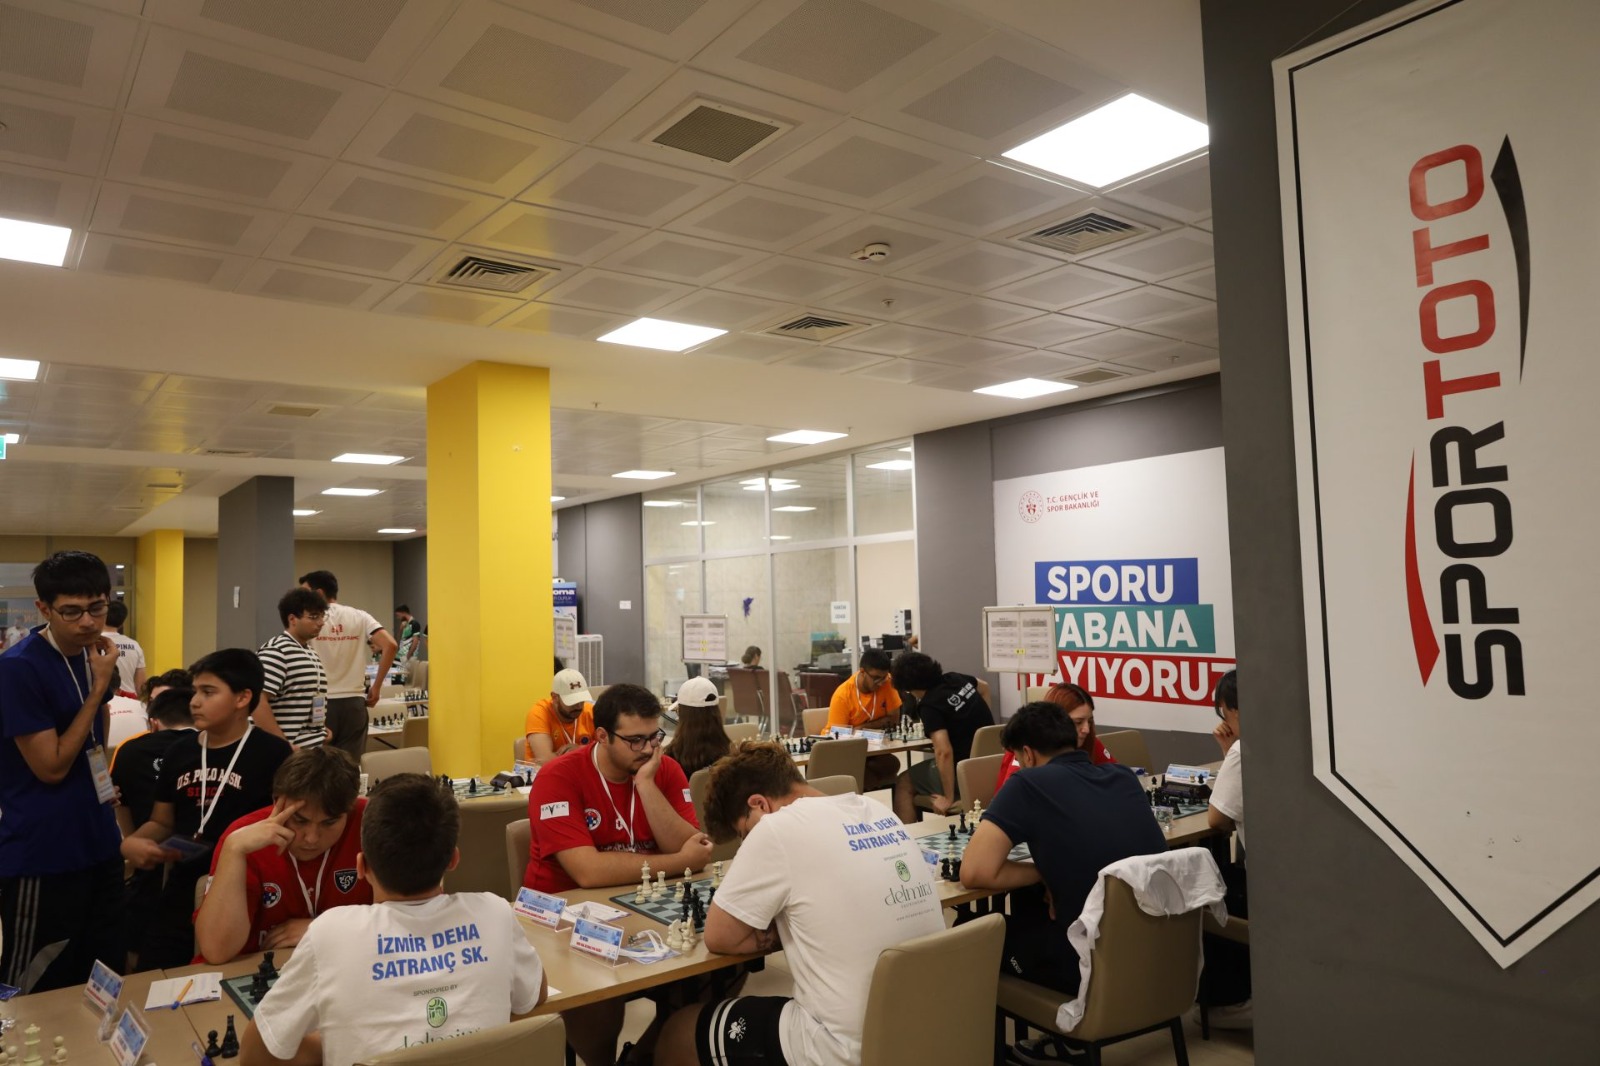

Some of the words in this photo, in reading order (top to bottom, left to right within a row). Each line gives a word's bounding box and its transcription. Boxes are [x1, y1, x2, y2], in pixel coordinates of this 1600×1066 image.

[1047, 504, 1064, 512] SPOR
[1065, 500, 1100, 511] BAKANLIĞI
[1060, 492, 1088, 502] GENÇLİK
[1047, 564, 1174, 603] SPORU
[1055, 609, 1198, 648] ABANA
[1030, 655, 1236, 702] AYIYORU
[217, 768, 242, 790] ASN.
[873, 817, 899, 831] DEHA
[848, 832, 901, 852] SATRANÇ
[377, 933, 427, 955] İZMİR
[431, 923, 480, 949] DEHA
[372, 952, 456, 981] SATRANÇ
[461, 946, 488, 965] SK.
[413, 986, 449, 997] SPONSORED
